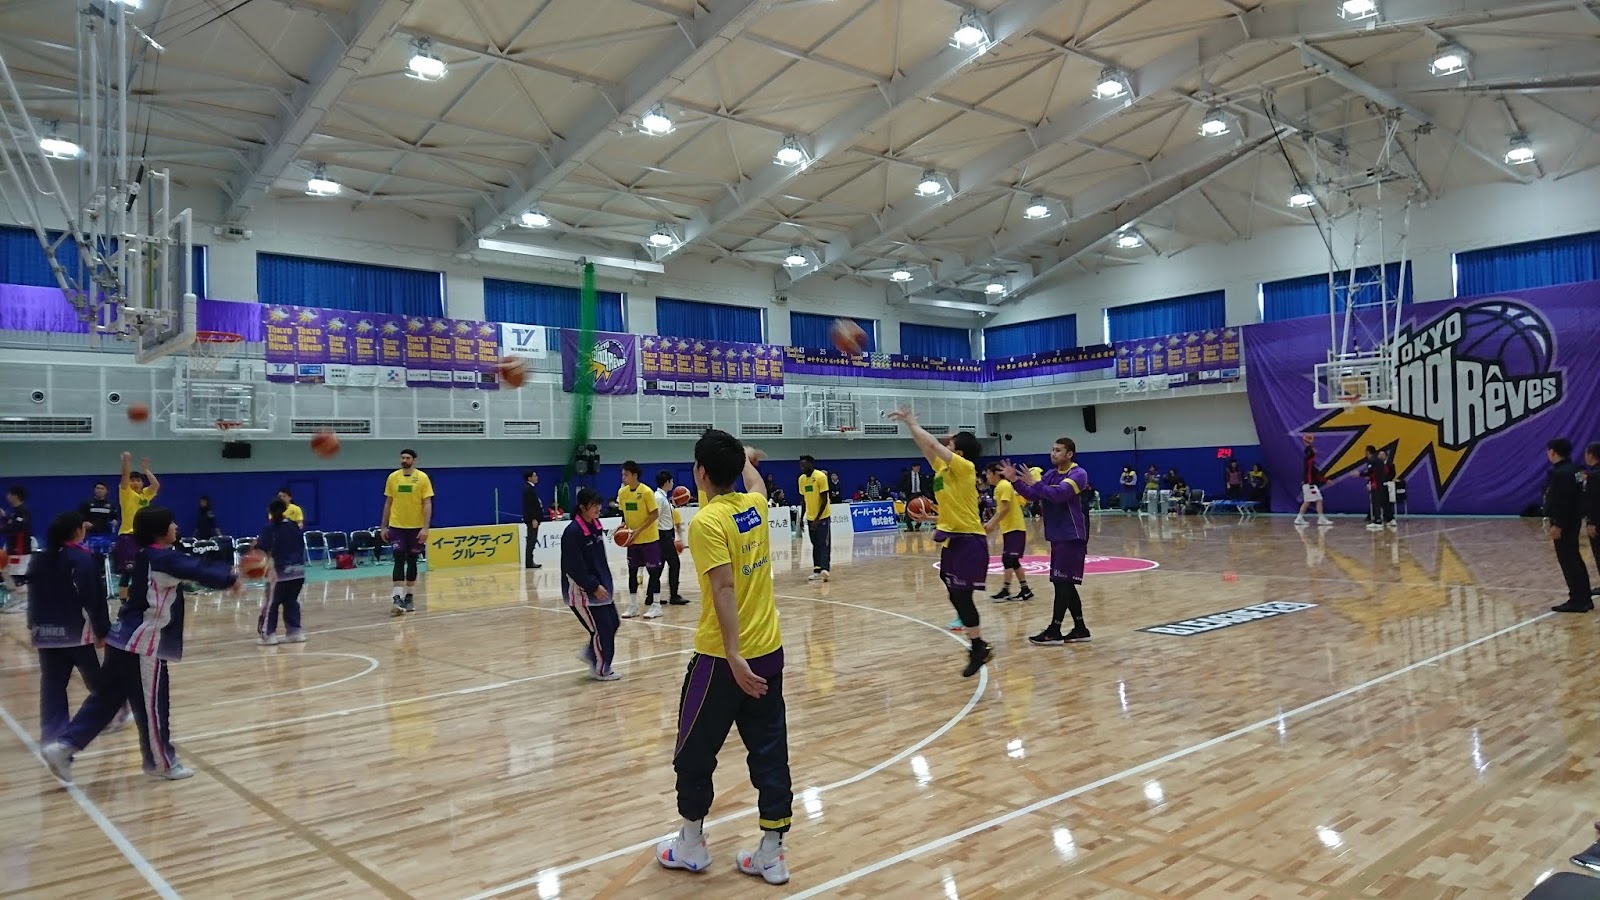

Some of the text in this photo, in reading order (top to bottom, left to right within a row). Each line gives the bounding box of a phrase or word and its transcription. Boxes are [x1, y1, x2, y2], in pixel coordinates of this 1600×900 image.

[1456, 360, 1556, 445] Rêves
[1217, 448, 1231, 458] 24
[871, 516, 895, 526] 株式会社
[432, 533, 513, 549] イーアクティブ
[452, 547, 496, 560] グループ
